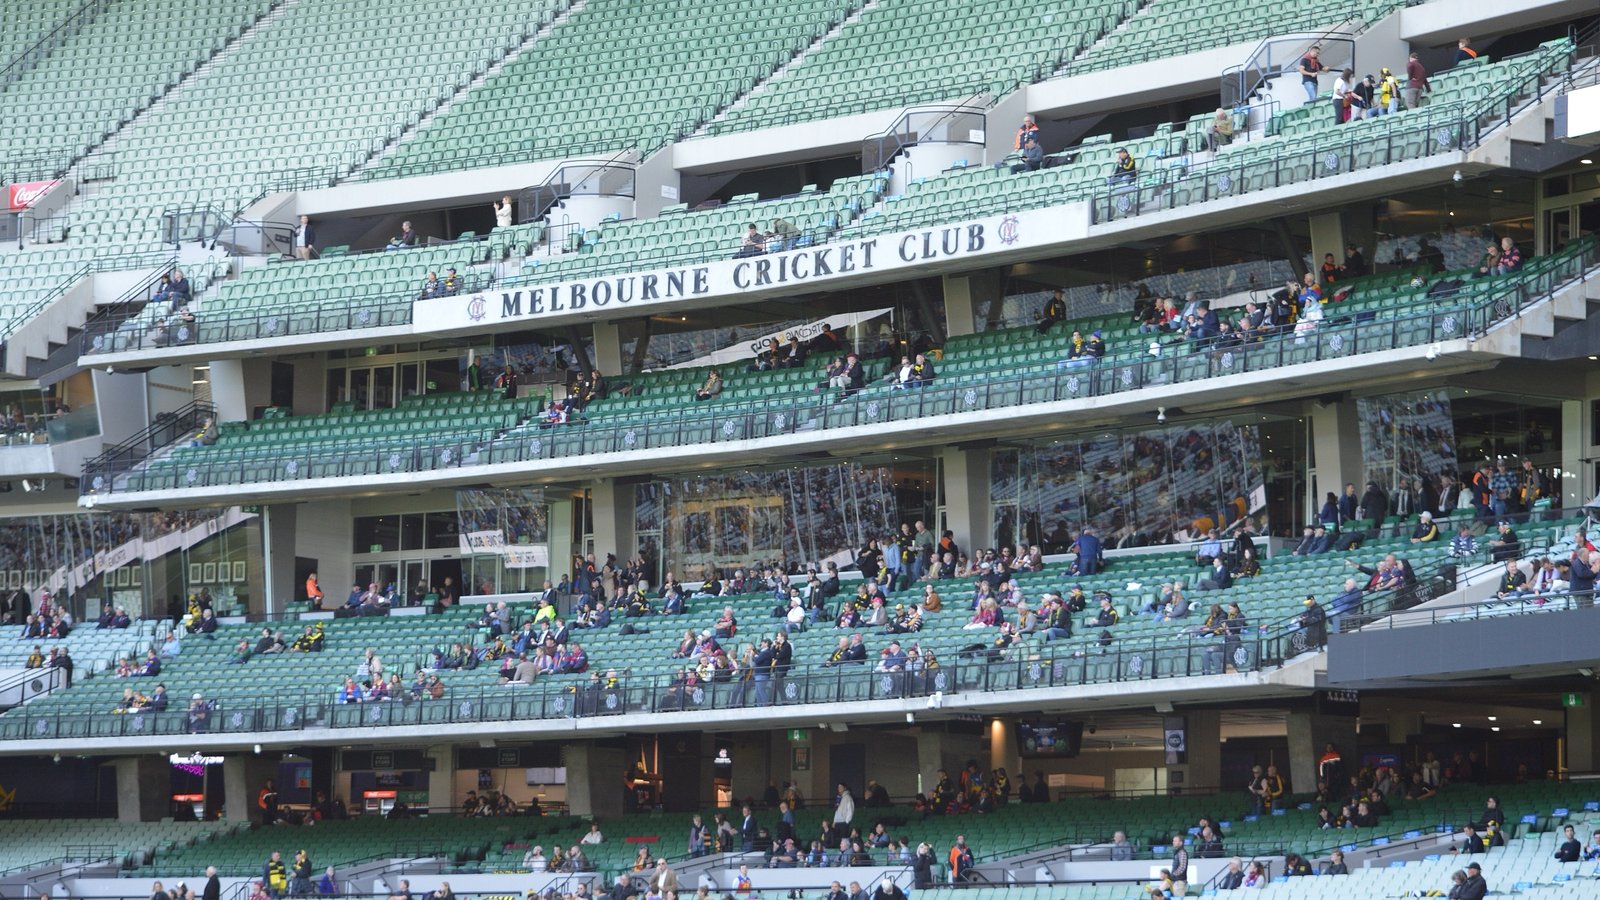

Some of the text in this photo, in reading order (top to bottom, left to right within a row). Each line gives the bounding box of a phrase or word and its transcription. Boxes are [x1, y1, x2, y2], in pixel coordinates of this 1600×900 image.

[500, 223, 985, 318] MELBOURNE CRICKET CLUB
